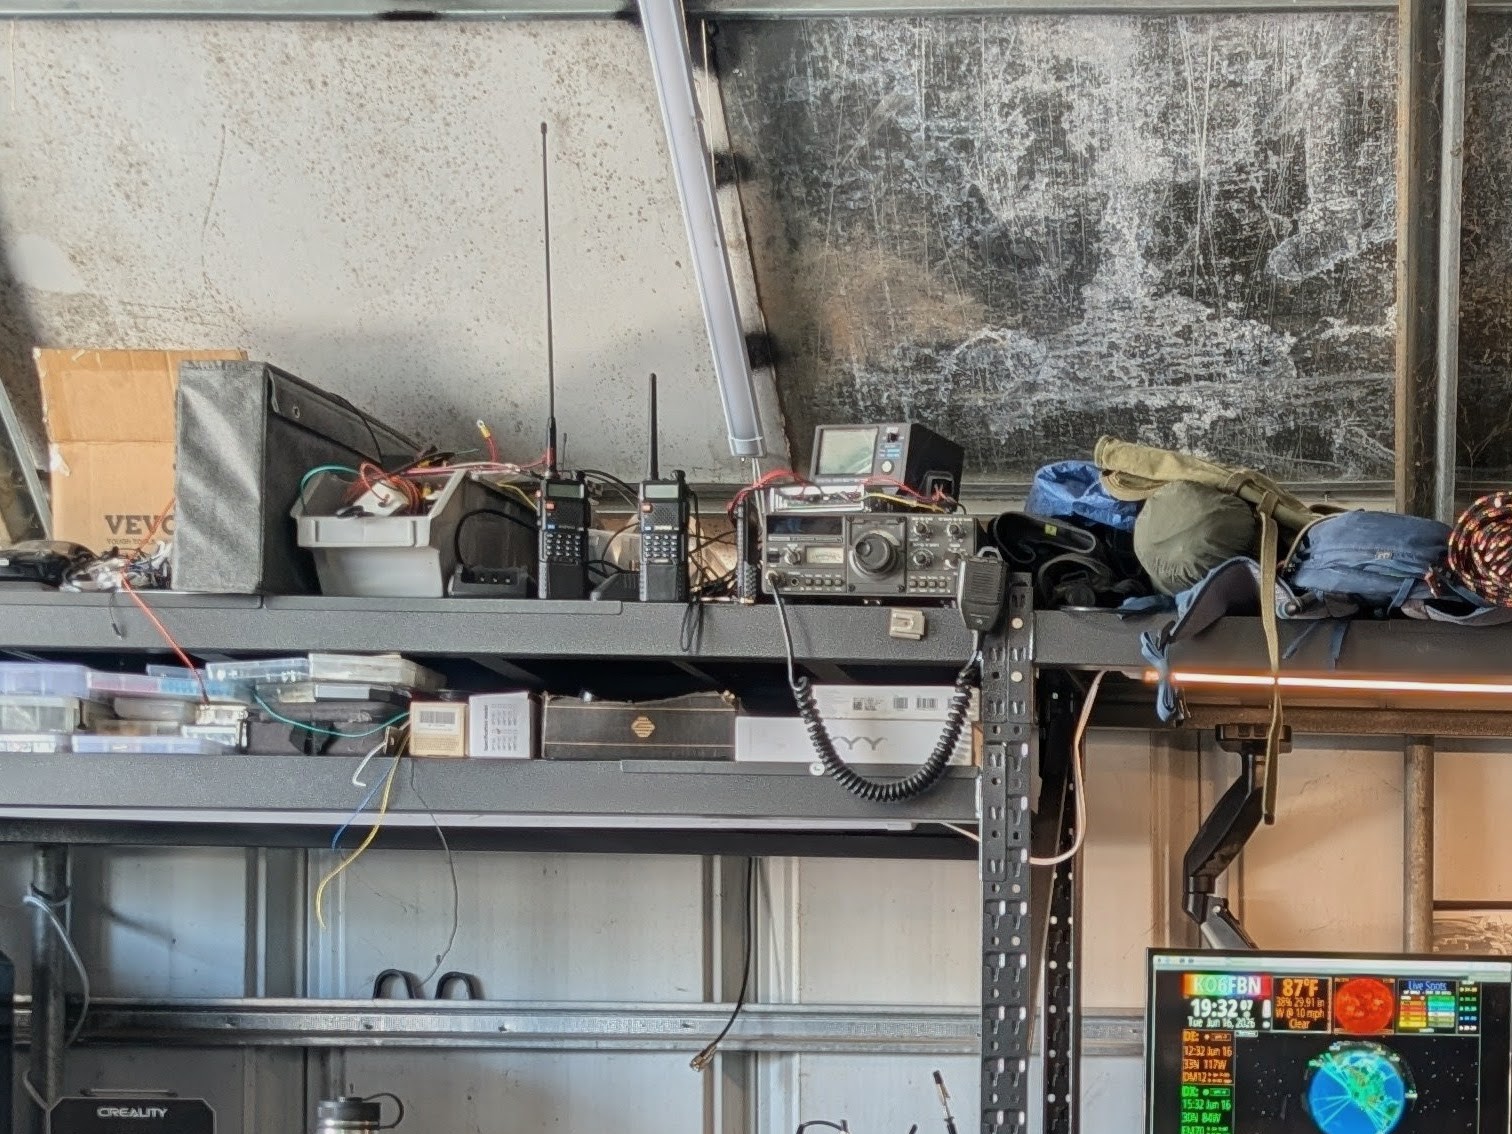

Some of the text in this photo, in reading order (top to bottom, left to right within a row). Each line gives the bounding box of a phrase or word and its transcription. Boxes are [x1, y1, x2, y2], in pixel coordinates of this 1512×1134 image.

[1194, 976, 1262, 994] KO6FBN
[1282, 979, 1319, 997] 87°F
[1190, 999, 1238, 1018] 19:32
[1296, 1008, 1305, 1018] 10
[1188, 1017, 1204, 1028] Tue
[1206, 1017, 1220, 1028] Jun
[1289, 1019, 1311, 1029] Clear
[1183, 1046, 1205, 1057] 12:32
[97, 1107, 168, 1118] CREALITY
